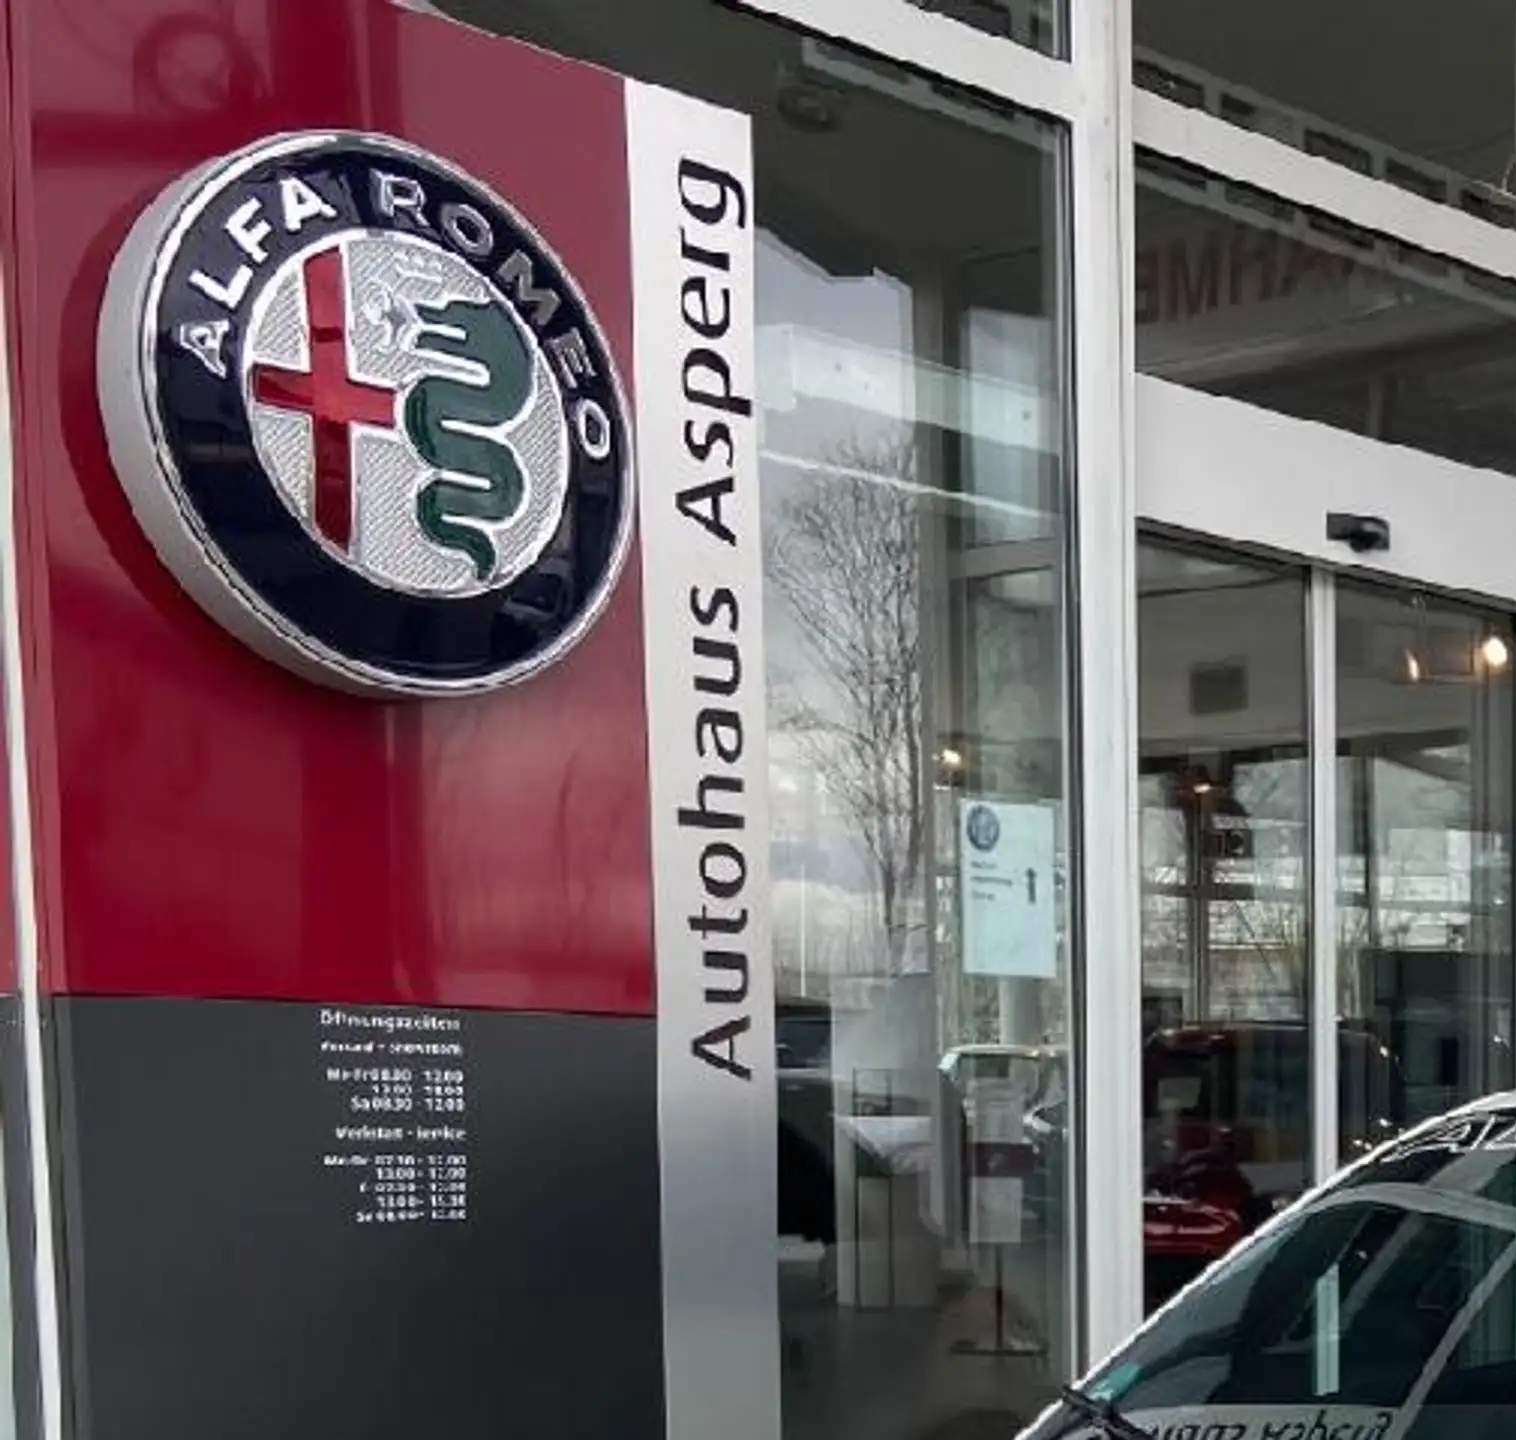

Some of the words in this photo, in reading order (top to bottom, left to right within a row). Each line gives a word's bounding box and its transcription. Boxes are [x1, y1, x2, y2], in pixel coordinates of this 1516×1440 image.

[180, 176, 336, 379] ALFA
[368, 168, 612, 460] ROMEO
[675, 156, 752, 548] Asperg
[678, 583, 753, 1081] Autohaus
